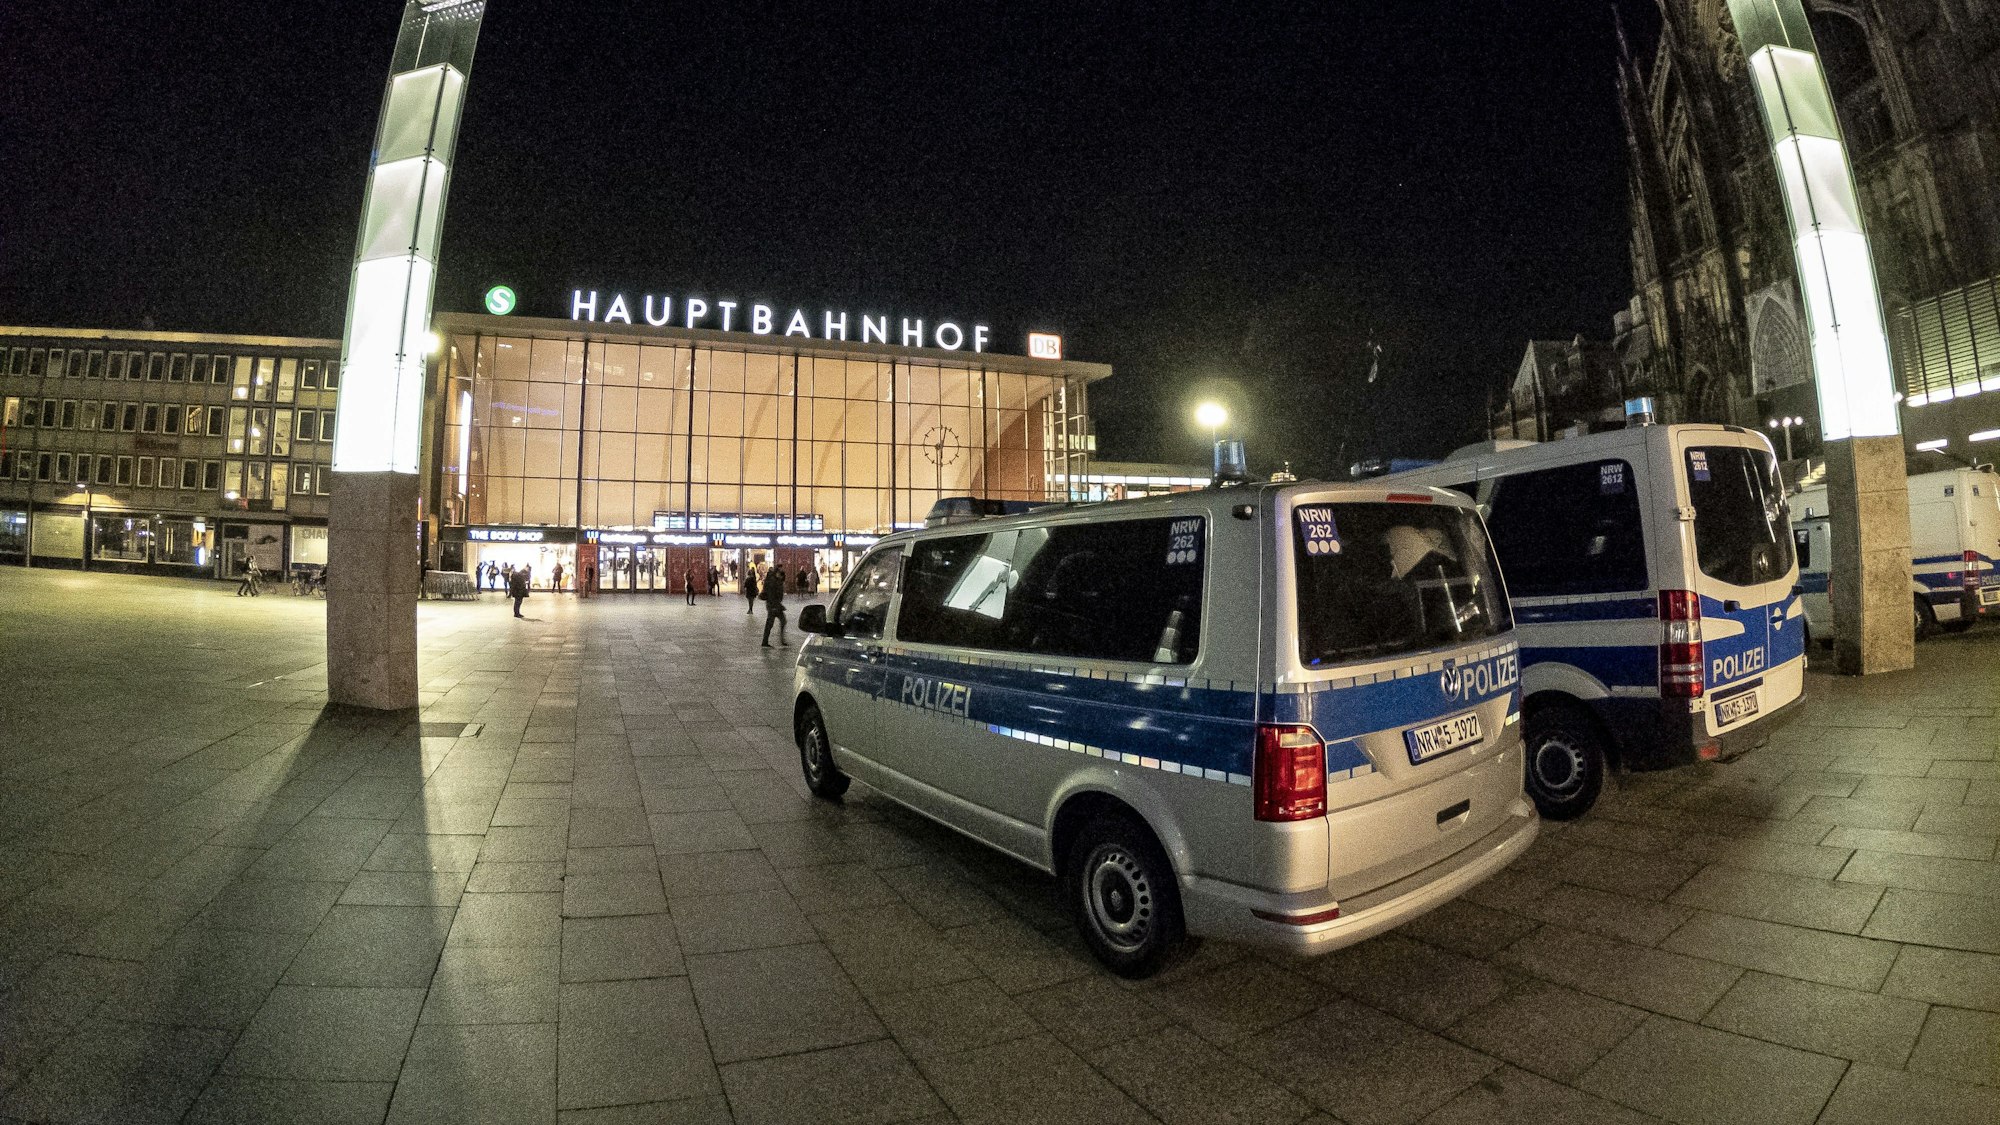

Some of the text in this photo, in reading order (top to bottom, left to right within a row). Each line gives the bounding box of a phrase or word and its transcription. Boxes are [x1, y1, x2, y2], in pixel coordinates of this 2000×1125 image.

[490, 288, 511, 312] S
[572, 290, 989, 353] HAUPTBAHNHOF
[1033, 338, 1057, 355] DB
[1690, 451, 1706, 460] NRW
[1601, 464, 1624, 475] NRW
[1693, 461, 1708, 471] 2612
[1602, 474, 1623, 485] 2612
[1298, 508, 1332, 523] NRW
[1170, 519, 1200, 535] NRW
[1308, 524, 1333, 538] 262
[1172, 535, 1194, 549] 262
[1713, 645, 1764, 683] POLIZEI
[1463, 653, 1519, 700] POLIZEI
[901, 675, 972, 718] POLIZEI
[1415, 715, 1478, 755] NRW 5-1927
